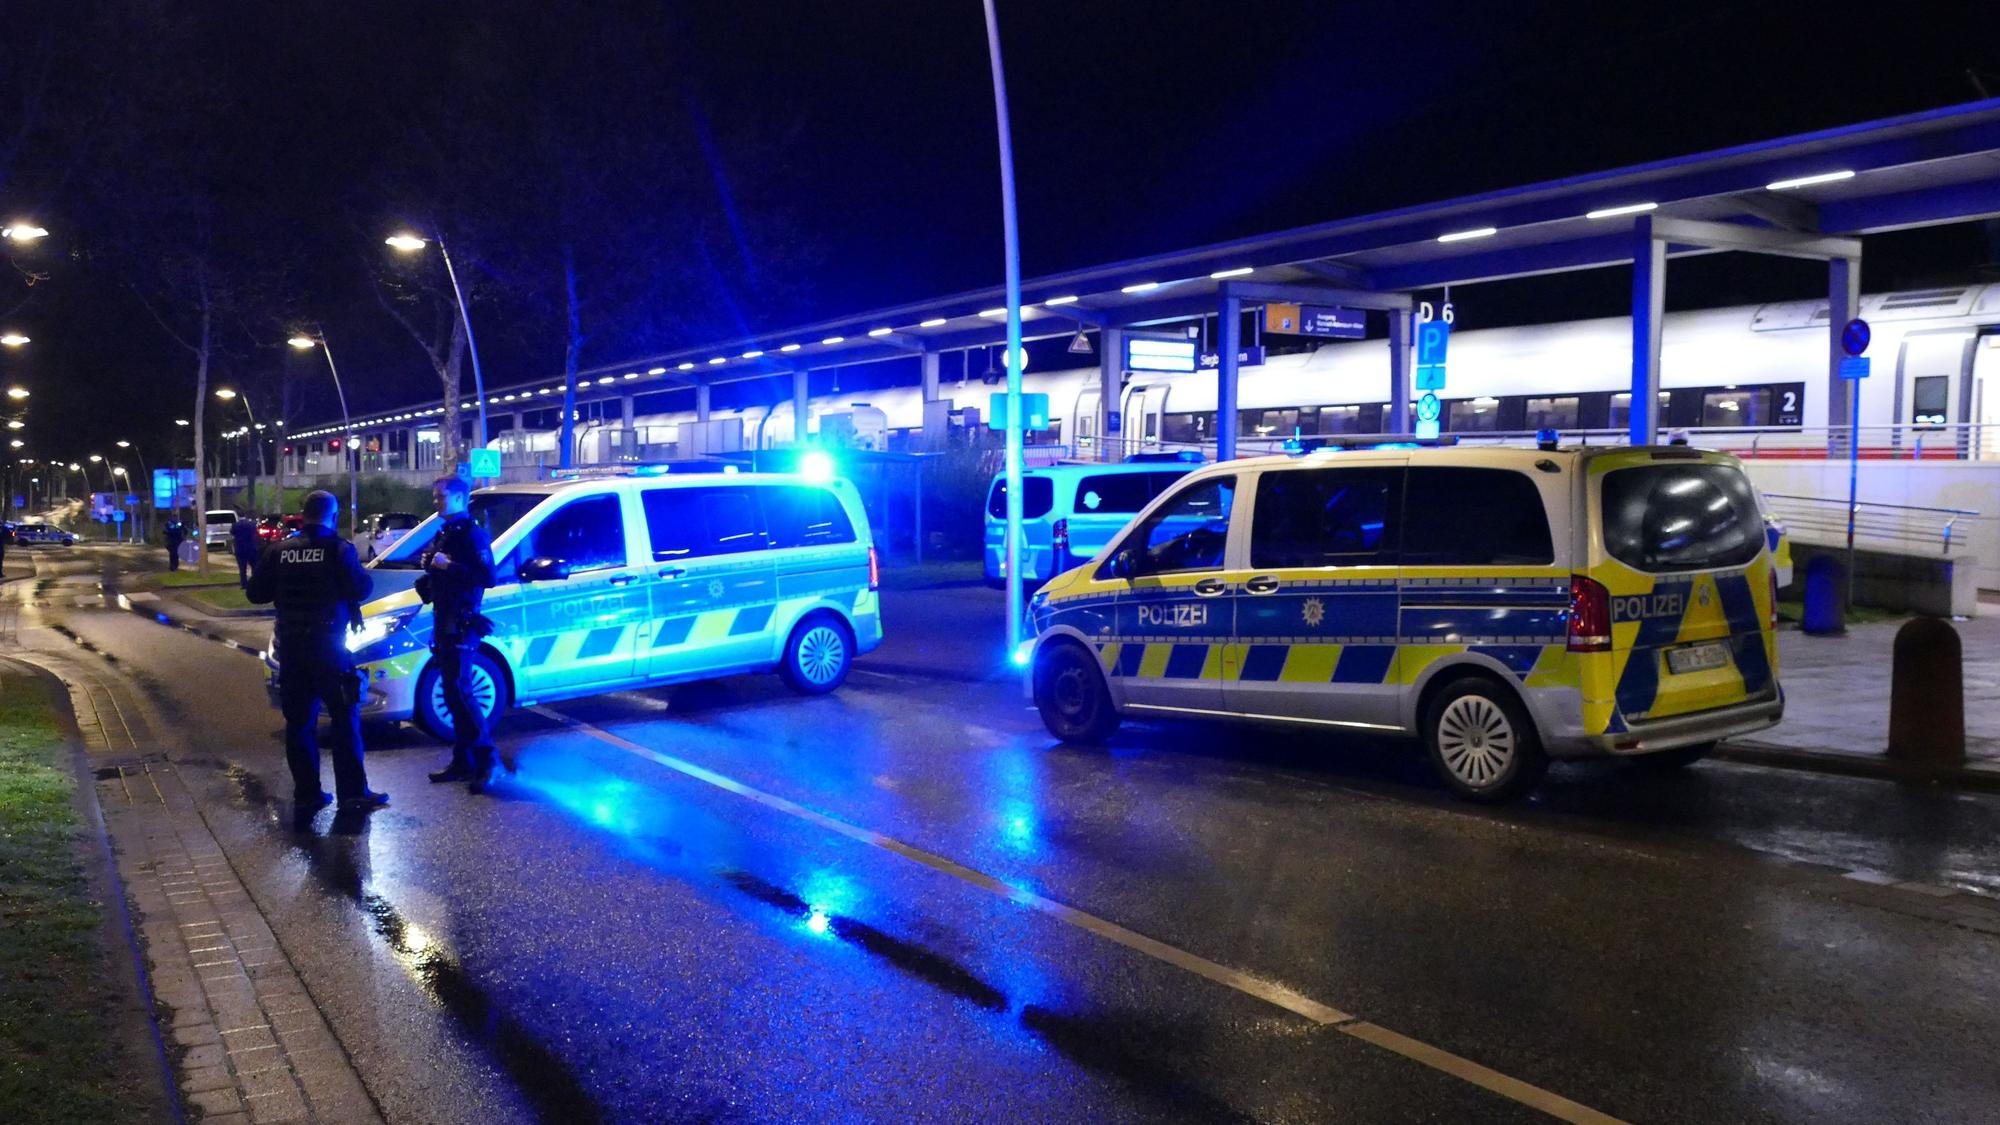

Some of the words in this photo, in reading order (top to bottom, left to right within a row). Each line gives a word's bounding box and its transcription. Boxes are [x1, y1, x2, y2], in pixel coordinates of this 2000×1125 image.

[1420, 302, 1434, 323] D
[1442, 303, 1454, 324] 6
[1425, 328, 1441, 360] P
[1782, 391, 1796, 412] 2
[1197, 416, 1204, 430] 2
[280, 548, 325, 563] POLIZEI
[550, 597, 624, 618] POLIZEI
[1138, 604, 1208, 626] POLIZEI
[1613, 592, 1683, 620] POLIZEI
